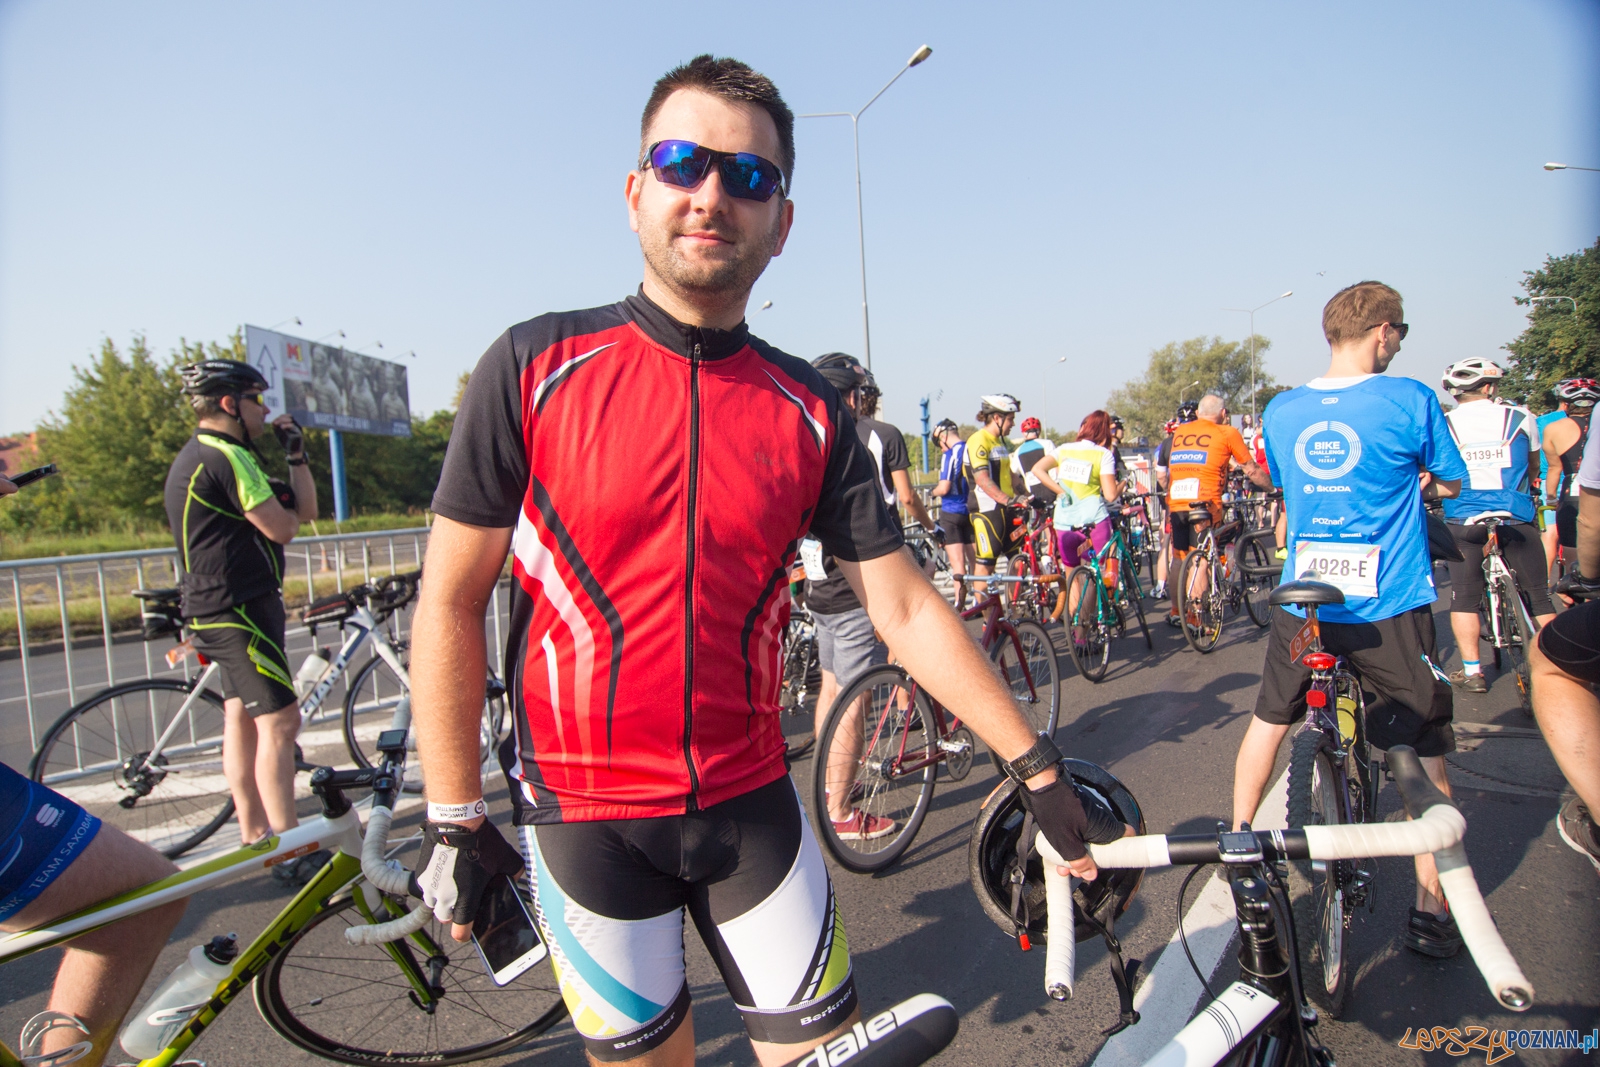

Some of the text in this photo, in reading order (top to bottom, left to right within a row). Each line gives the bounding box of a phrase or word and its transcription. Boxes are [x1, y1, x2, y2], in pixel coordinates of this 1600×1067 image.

[1173, 434, 1212, 448] CCC
[1314, 441, 1340, 450] BIKE
[1465, 449, 1504, 462] 3139-H
[1316, 484, 1352, 493] ŠKODA
[1308, 557, 1368, 578] 4928-E
[300, 653, 348, 717] GIANT
[29, 856, 63, 889] TEAM
[178, 921, 301, 1038] TREK
[613, 1011, 676, 1050] Berkner
[334, 1047, 444, 1064] BONTRAGER
